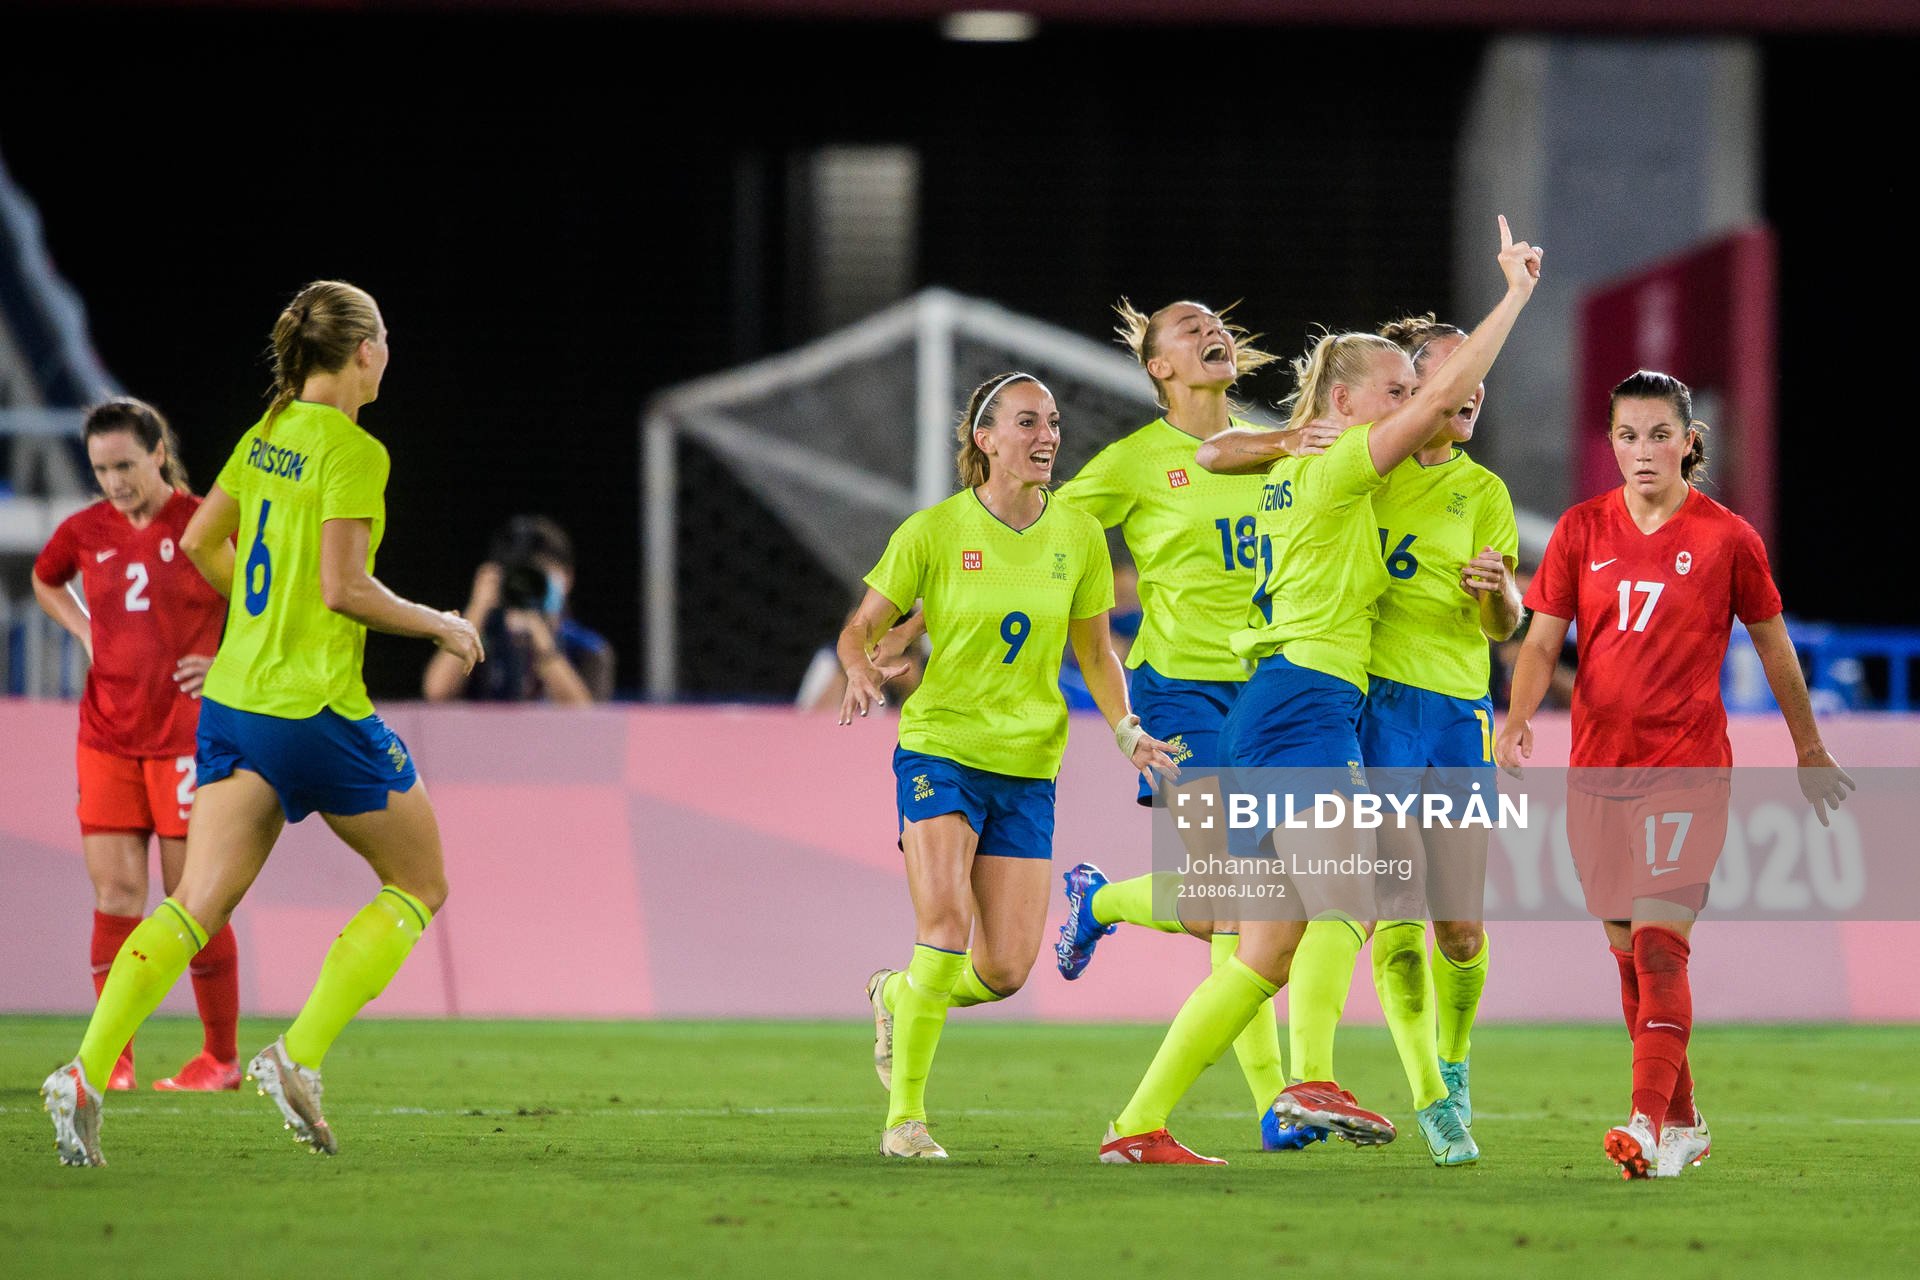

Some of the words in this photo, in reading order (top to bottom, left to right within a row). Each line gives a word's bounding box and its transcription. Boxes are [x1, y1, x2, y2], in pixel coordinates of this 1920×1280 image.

[1168, 470, 1185, 479] UNI
[1446, 505, 1466, 519] SWE
[245, 498, 272, 617] 6
[964, 552, 979, 560] UNI
[1215, 515, 1257, 571] 18
[964, 561, 981, 569] QLO
[1051, 572, 1067, 580] SWE
[125, 563, 150, 612] 2
[1617, 580, 1665, 633] 17
[1000, 611, 1032, 665] 9
[1173, 749, 1194, 765] SWE
[175, 755, 197, 805] 2
[914, 788, 936, 802] SWE
[1644, 811, 1694, 866] 17
